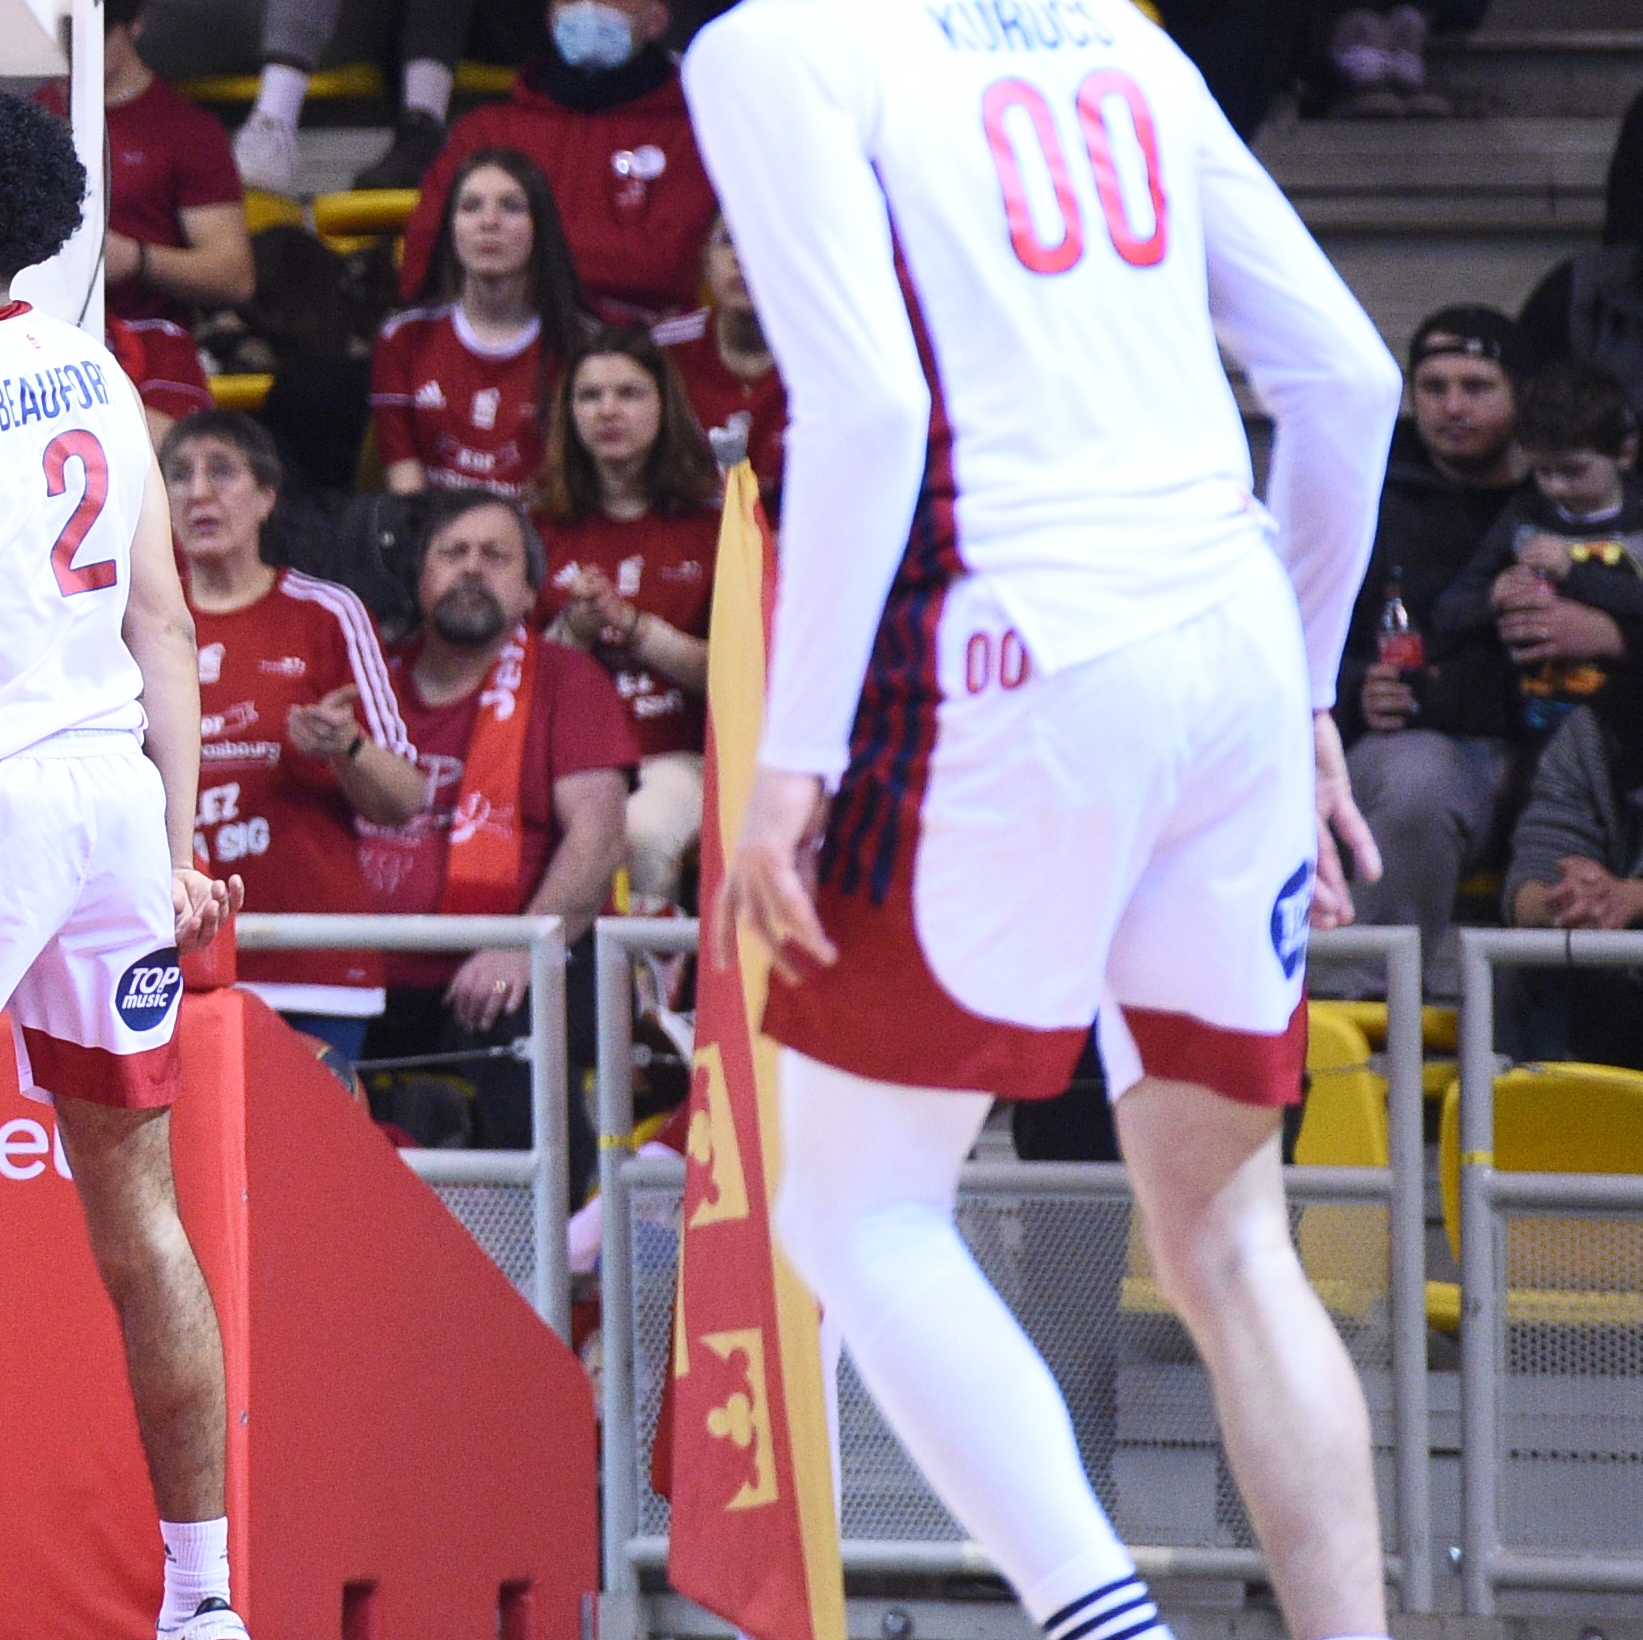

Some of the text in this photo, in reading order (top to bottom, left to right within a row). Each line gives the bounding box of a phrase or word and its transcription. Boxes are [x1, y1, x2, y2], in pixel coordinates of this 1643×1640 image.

[981, 67, 1168, 274] 00
[41, 428, 118, 598] 2
[121, 992, 169, 1010] music
[128, 966, 180, 995] TOP
